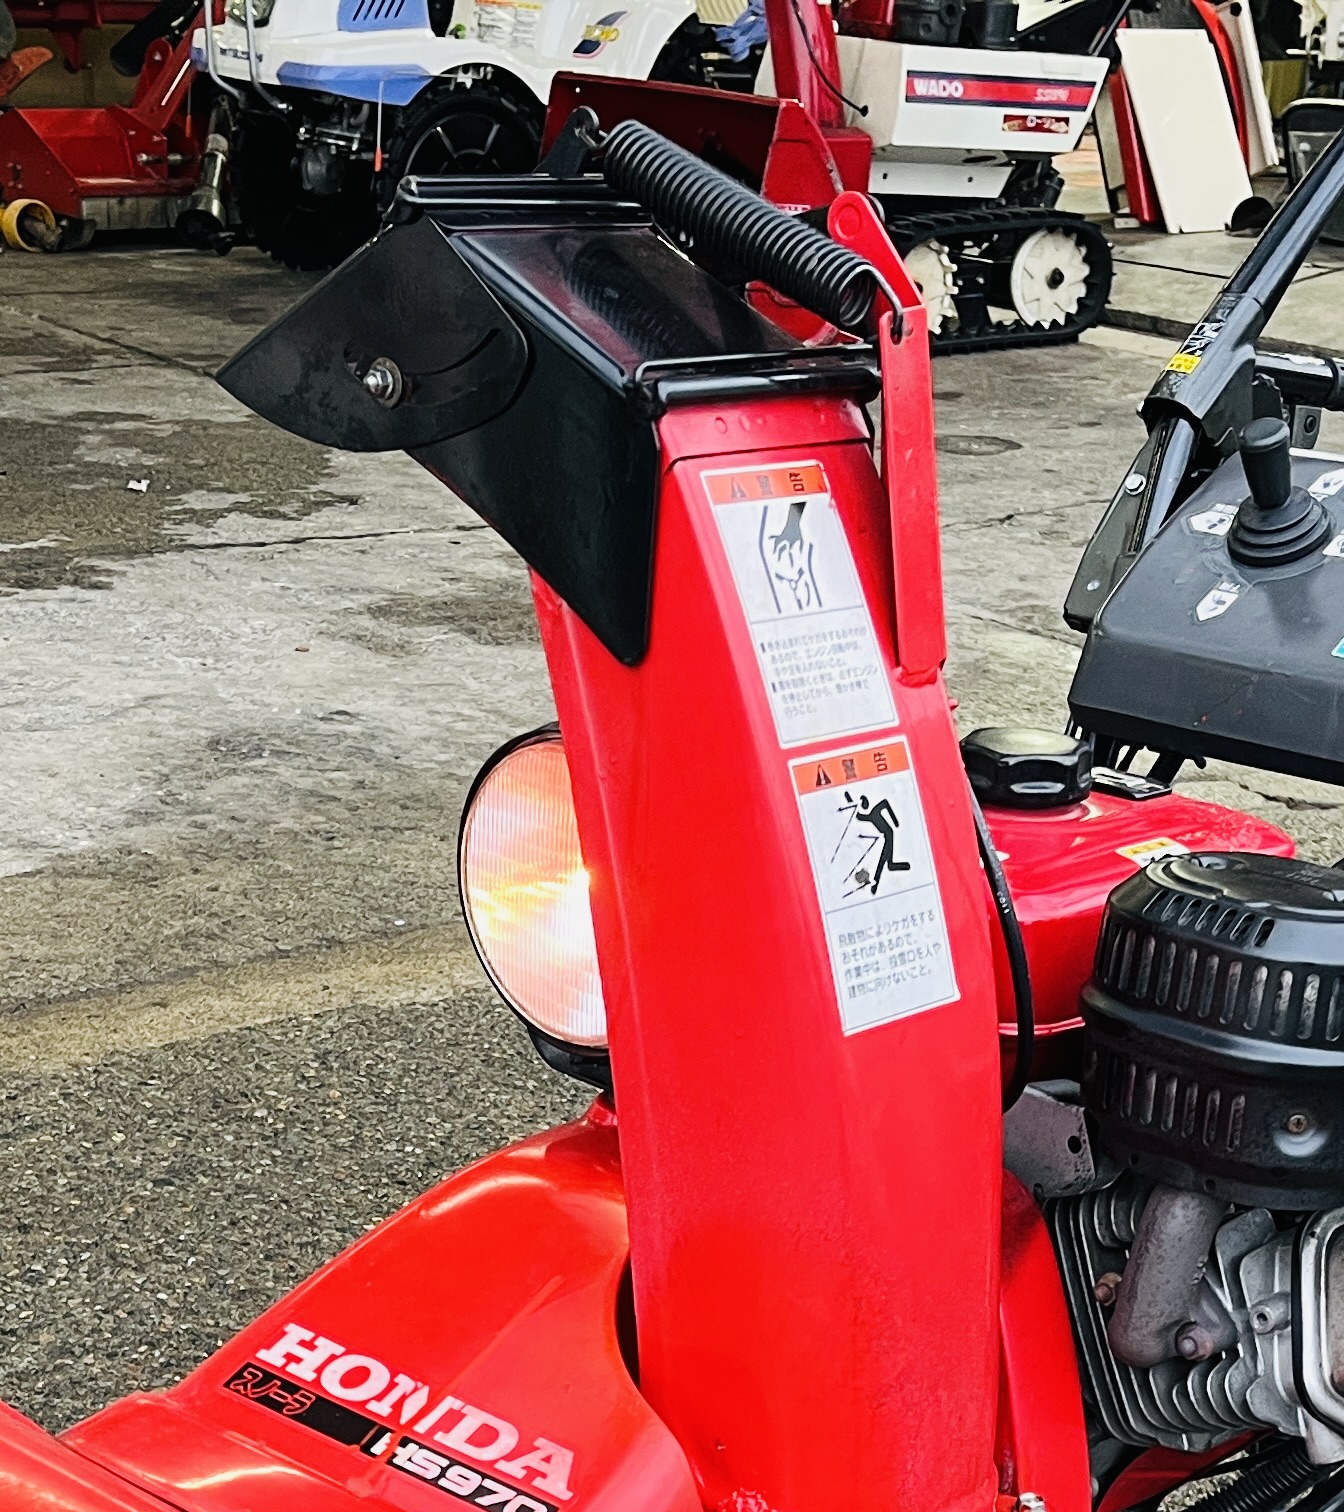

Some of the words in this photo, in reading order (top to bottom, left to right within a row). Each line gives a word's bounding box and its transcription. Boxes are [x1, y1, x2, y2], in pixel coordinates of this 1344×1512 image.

[913, 78, 964, 98] WADO
[229, 1367, 317, 1415] スノーラ
[255, 1322, 576, 1501] HONDA
